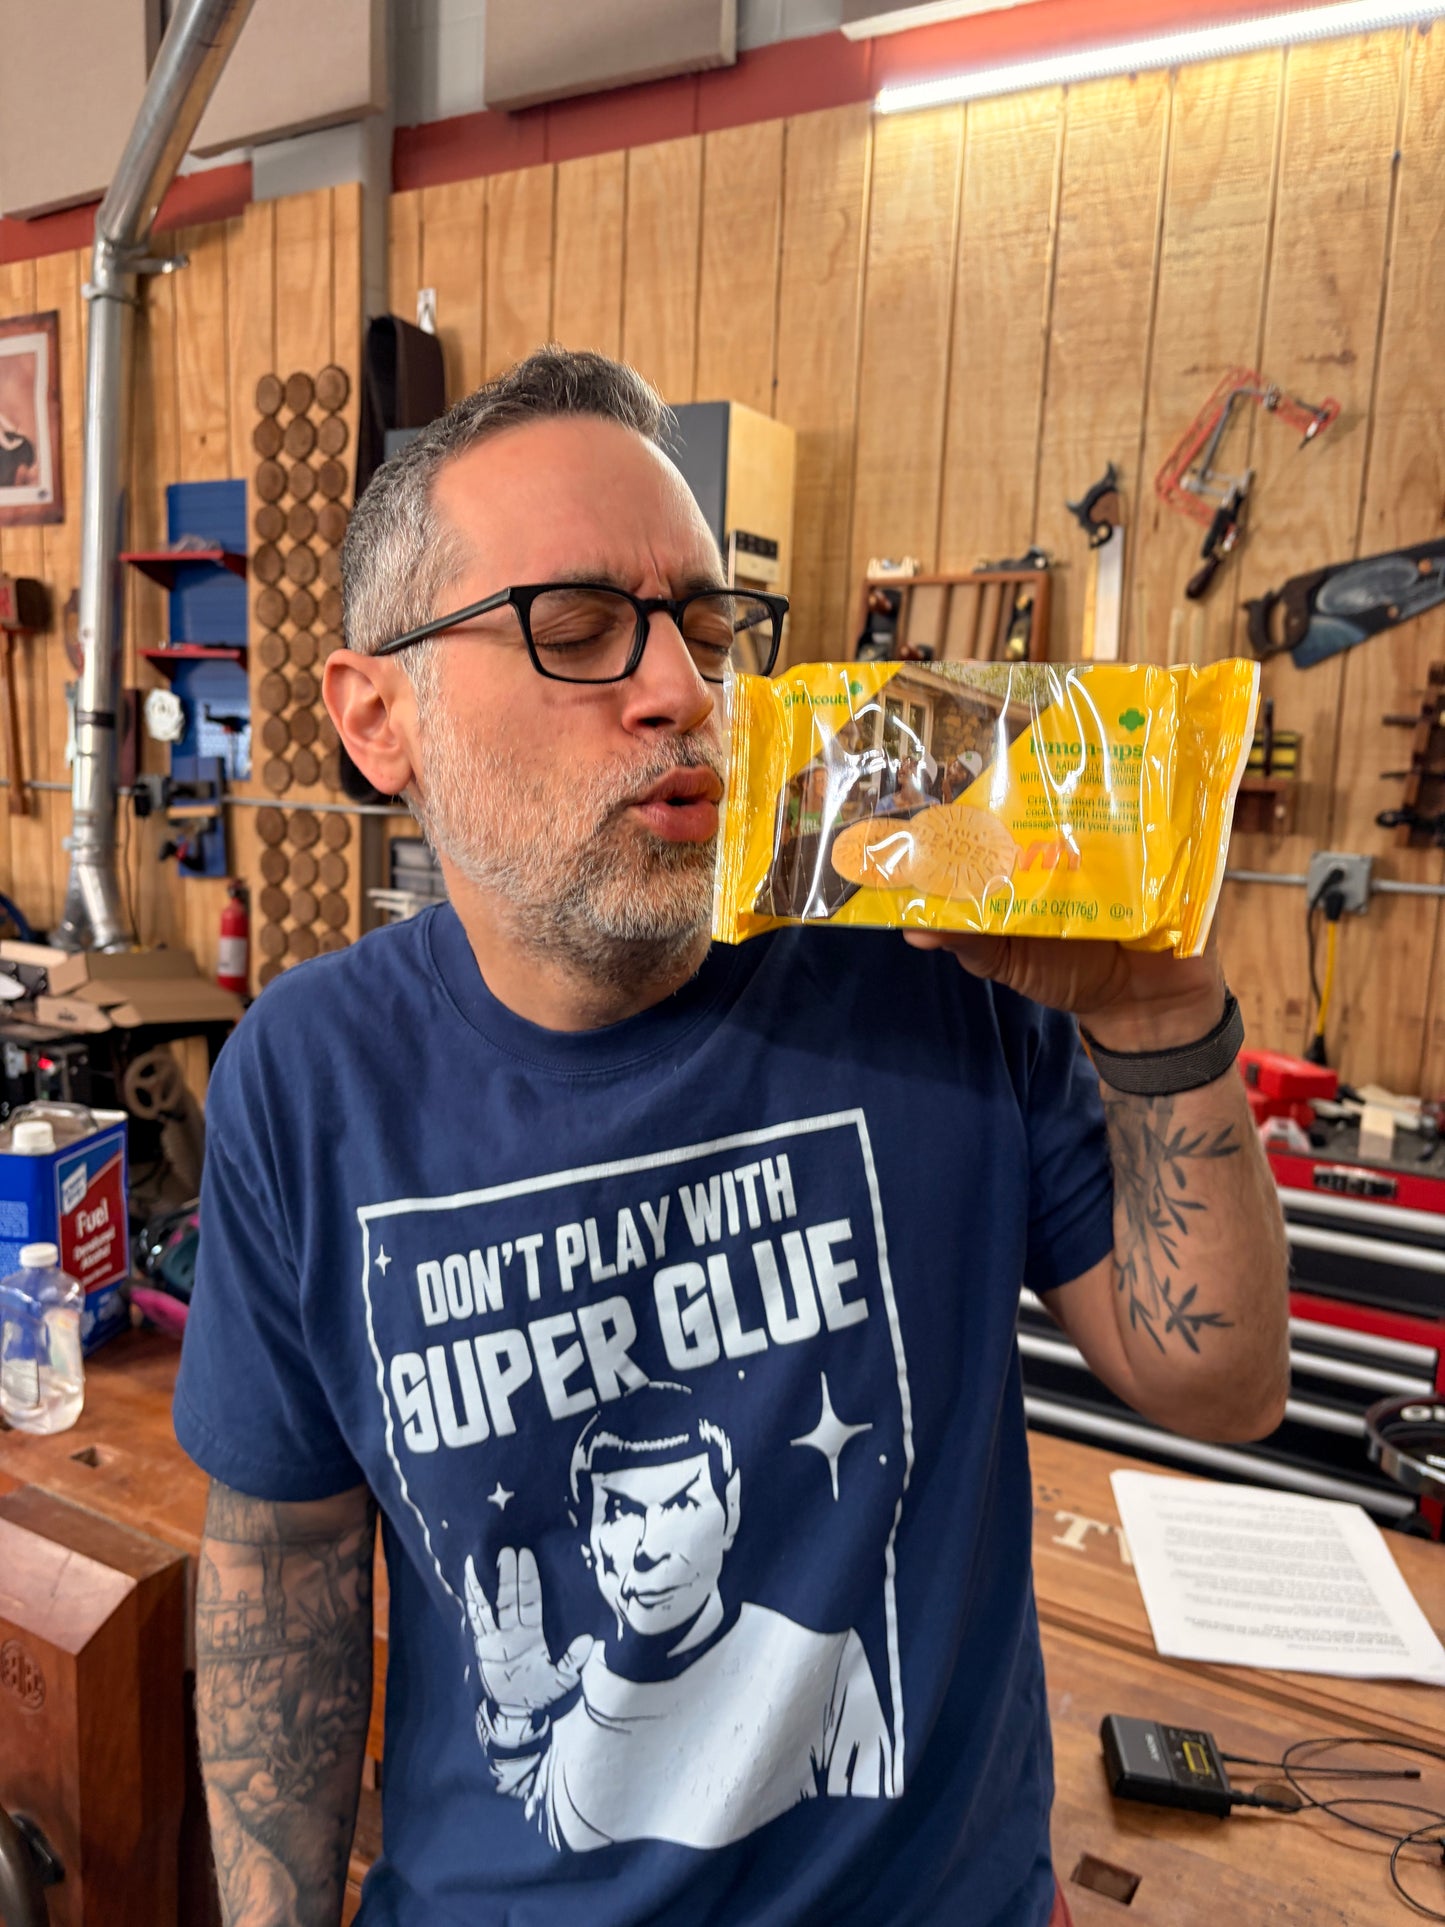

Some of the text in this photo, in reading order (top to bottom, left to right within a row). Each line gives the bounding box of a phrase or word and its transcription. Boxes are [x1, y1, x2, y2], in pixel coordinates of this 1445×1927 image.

[784, 690, 806, 708] girl
[1056, 760, 1101, 773] NATUALLY
[1020, 770, 1040, 784] WITH
[1097, 797, 1139, 809] flaored
[1066, 806, 1088, 818] with
[1013, 820, 1058, 832] message
[1088, 822, 1109, 834] your
[990, 898, 1011, 914] NET
[1012, 898, 1028, 915] WT
[1031, 899, 1047, 916] 6.2
[75, 1196, 109, 1239] Fuel
[416, 1154, 797, 1327] DON'T PLAY WITH
[389, 1217, 869, 1453] SUPER GLUE
